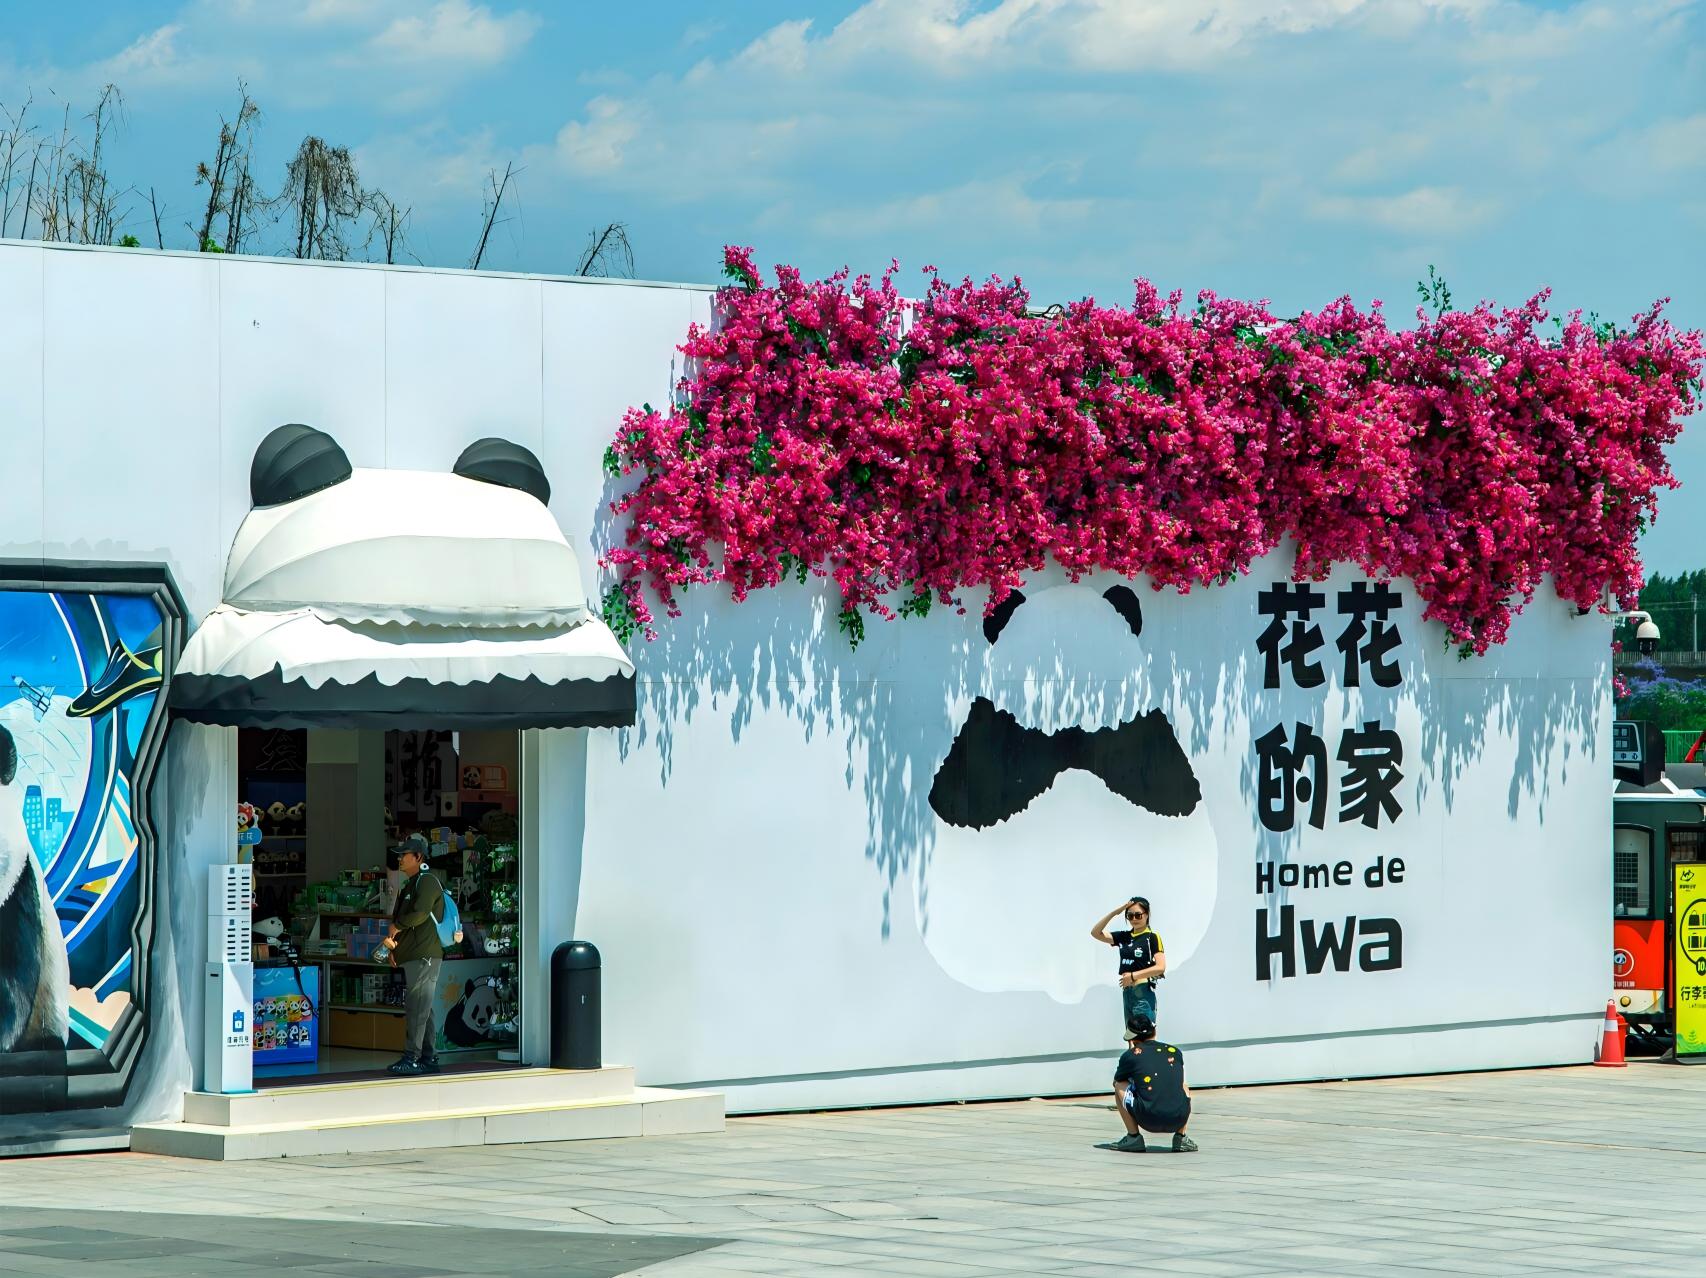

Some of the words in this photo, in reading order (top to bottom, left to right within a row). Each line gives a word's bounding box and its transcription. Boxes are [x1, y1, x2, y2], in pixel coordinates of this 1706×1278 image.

[1256, 582, 1403, 689] 花花
[1255, 720, 1404, 832] 的家
[1257, 861, 1353, 894] Home
[1364, 856, 1406, 888] de
[1256, 905, 1403, 981] Hwa
